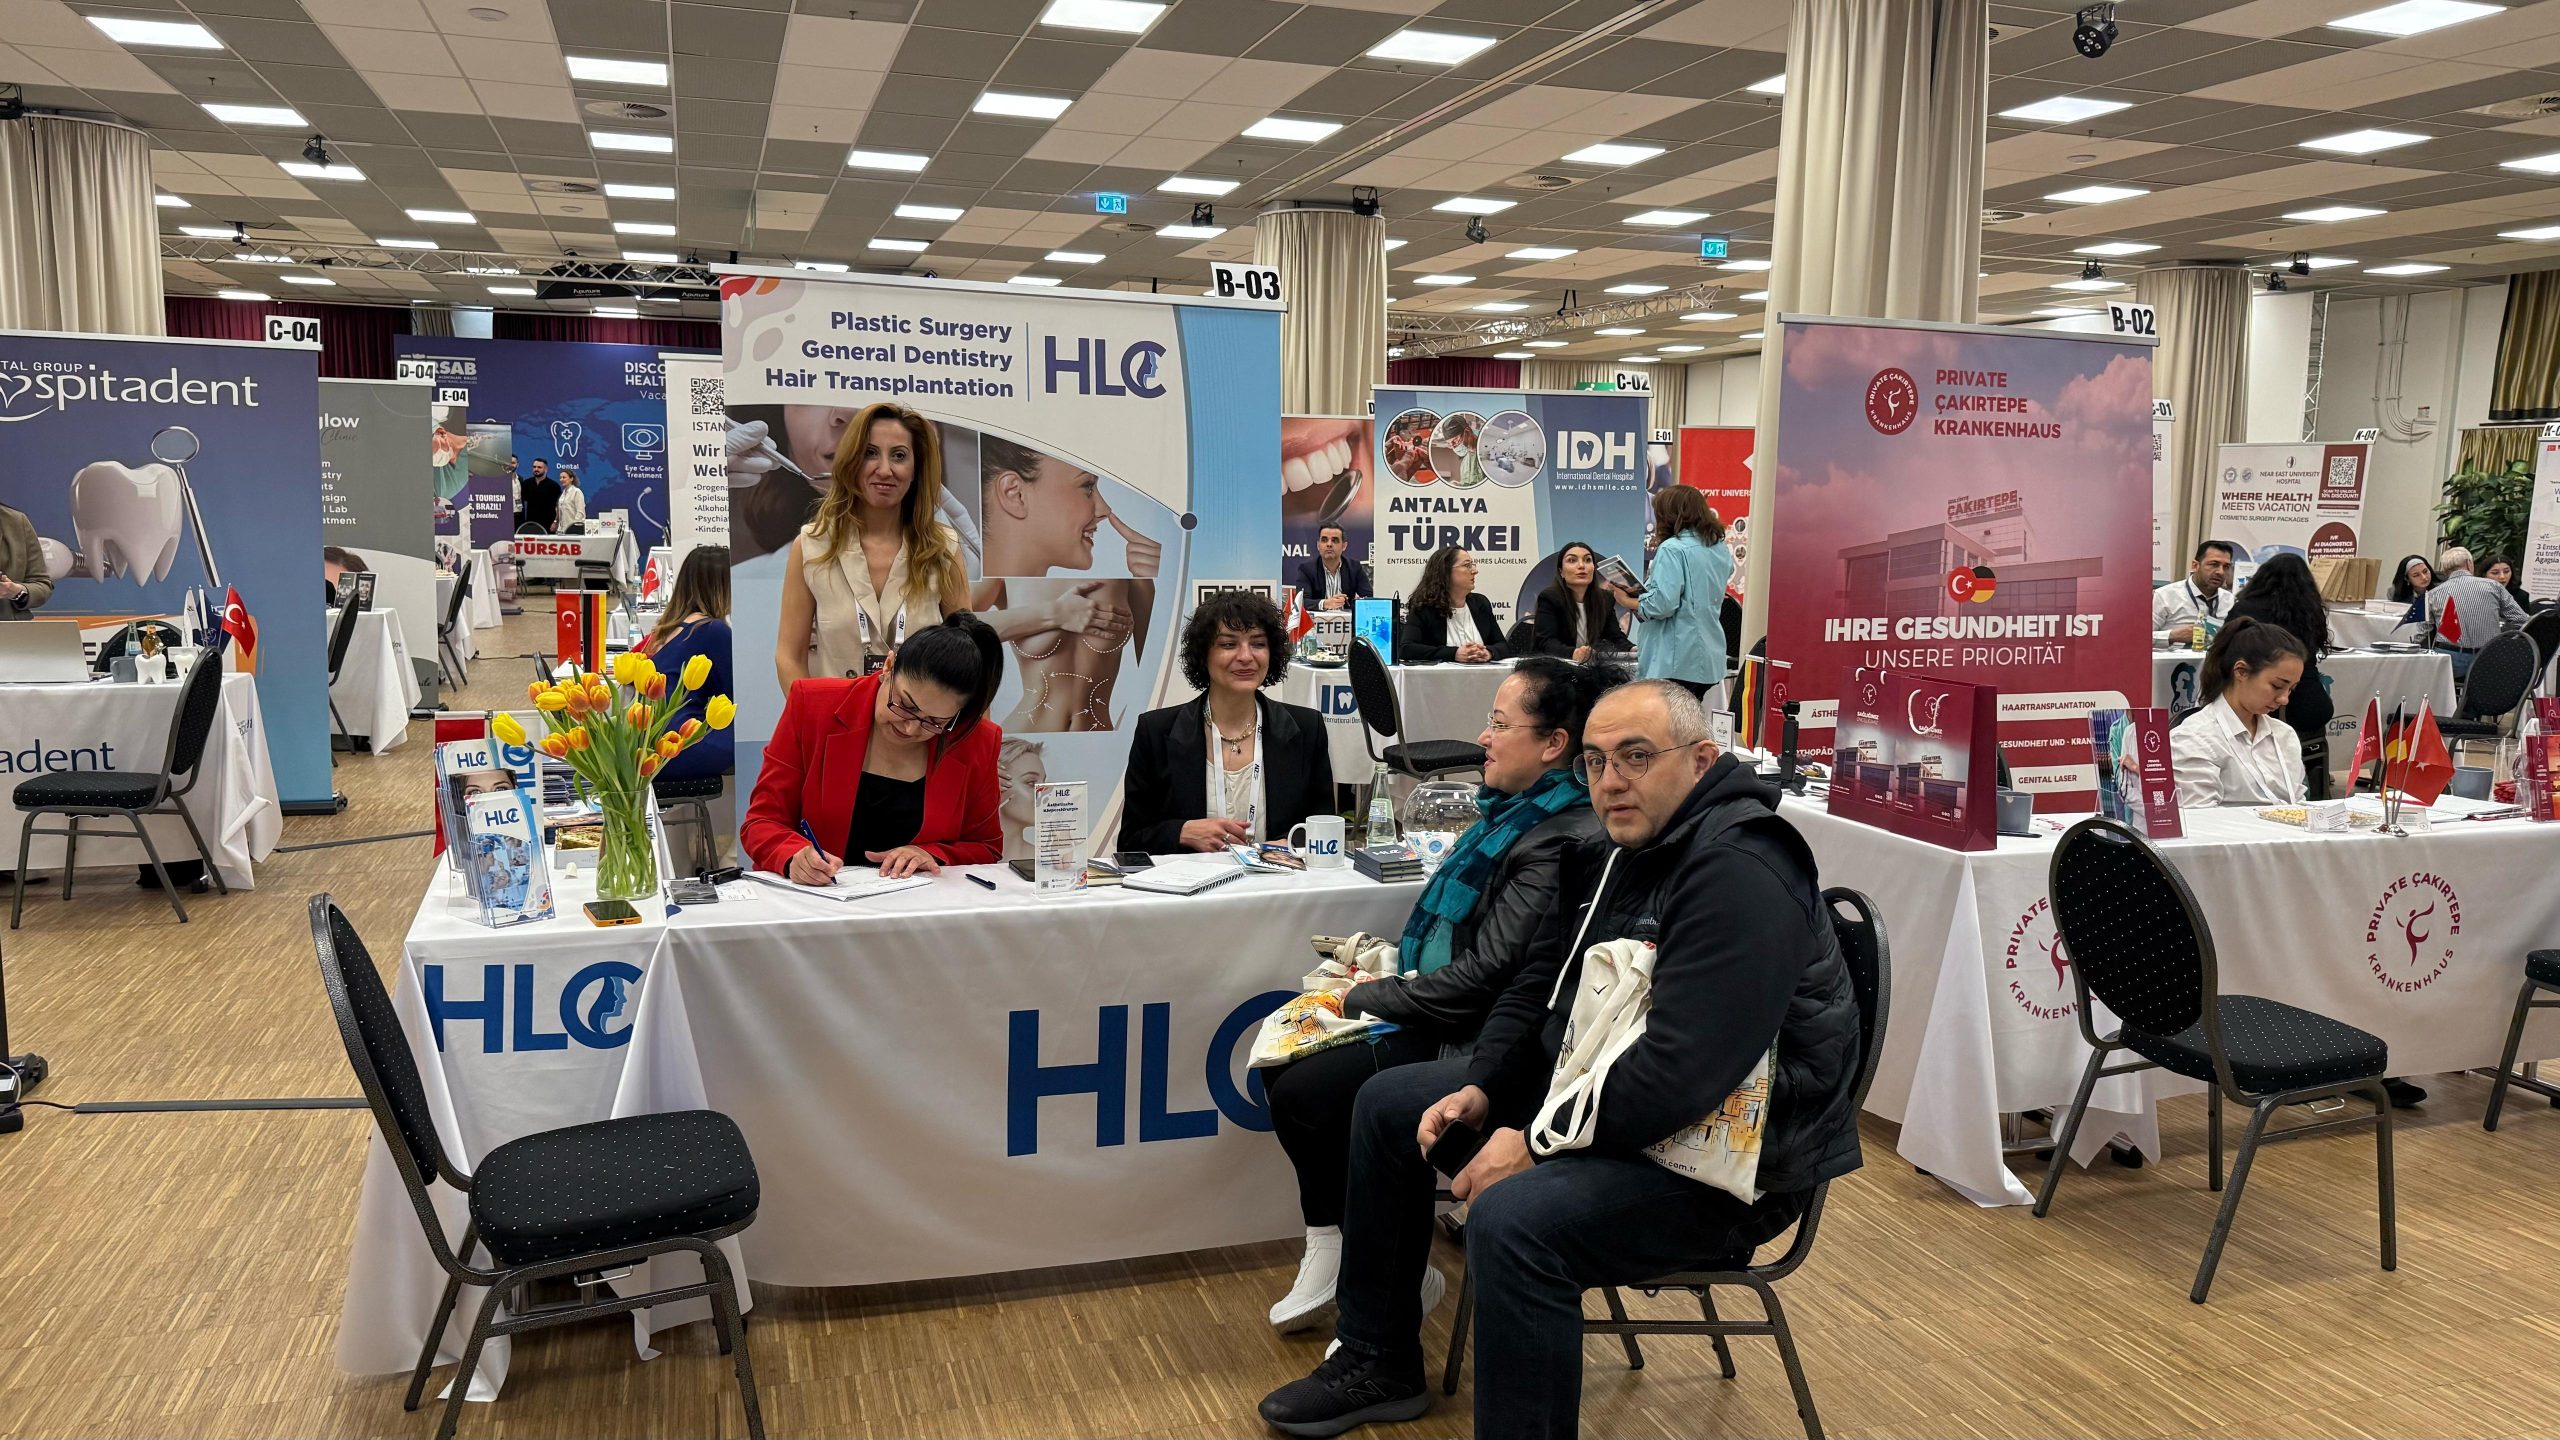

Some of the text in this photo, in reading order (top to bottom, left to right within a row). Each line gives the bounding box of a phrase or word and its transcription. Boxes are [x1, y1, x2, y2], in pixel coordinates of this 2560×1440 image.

[1216, 269, 1281, 301] B-03
[830, 311, 1013, 343] Plastic Surgery
[2112, 307, 2156, 335] B-02
[268, 319, 319, 343] C-04
[801, 340, 1013, 372] General Dentistry
[33, 361, 83, 373] GROUP
[399, 364, 434, 379] D-04
[1044, 335, 1167, 399] HLC
[765, 367, 1014, 402] Hair Transplantation
[1617, 373, 1650, 390] C-02
[1935, 369, 2008, 388] PRIVATE
[442, 390, 466, 401] E-04
[1869, 373, 1915, 406] PRIVATE ÇAKIRTEPE
[1934, 394, 2028, 414] ÇAKIRTEPE
[1869, 409, 1912, 431] KRANKENHAUS
[1656, 431, 1671, 441] E-01
[1933, 419, 2062, 439] KRANKENHAUS
[2355, 430, 2377, 441] K-04
[692, 444, 720, 457] Wir
[1556, 431, 1636, 470] IDH
[556, 462, 579, 470] Dental
[625, 465, 637, 473] Eye
[693, 464, 727, 477] Welt
[1556, 472, 1635, 481] International Dental Hospital
[475, 494, 505, 502] TOURISM
[1389, 497, 1488, 513] ANTALYA
[2222, 492, 2313, 502] WHERE HEALTH
[329, 505, 348, 513] Lab
[476, 503, 501, 511] BRAZIL!
[2221, 502, 2255, 511] MEETS
[2258, 503, 2310, 512] VACATION
[1388, 517, 1520, 551] TÜRKEI
[514, 539, 582, 556] TÜRSAB
[1493, 557, 1527, 565] LÄCHELNS
[1315, 621, 1351, 634] ETEE
[1824, 614, 2104, 642] IHRE GESUNDHEIT IST
[1865, 642, 2065, 669] UNSERE PRIORITÄT
[2001, 701, 2096, 712] HAARTRANSPLANTATION
[1998, 739, 2048, 748] GESUNDHEIT
[2049, 739, 2064, 747] UND
[457, 751, 488, 768] HLC
[2018, 775, 2078, 784] GENITAL LASER
[1055, 789, 1071, 797] HLC
[485, 808, 519, 827] HLC
[1308, 839, 1339, 855] HLC
[2367, 872, 2461, 943] PRIVATE ÇAKIRTEPE
[2006, 897, 2049, 969] PRIVATE
[2367, 948, 2454, 992] KRANKENHAUS
[424, 961, 644, 1053] HLC
[1007, 990, 1302, 1157] HLC
